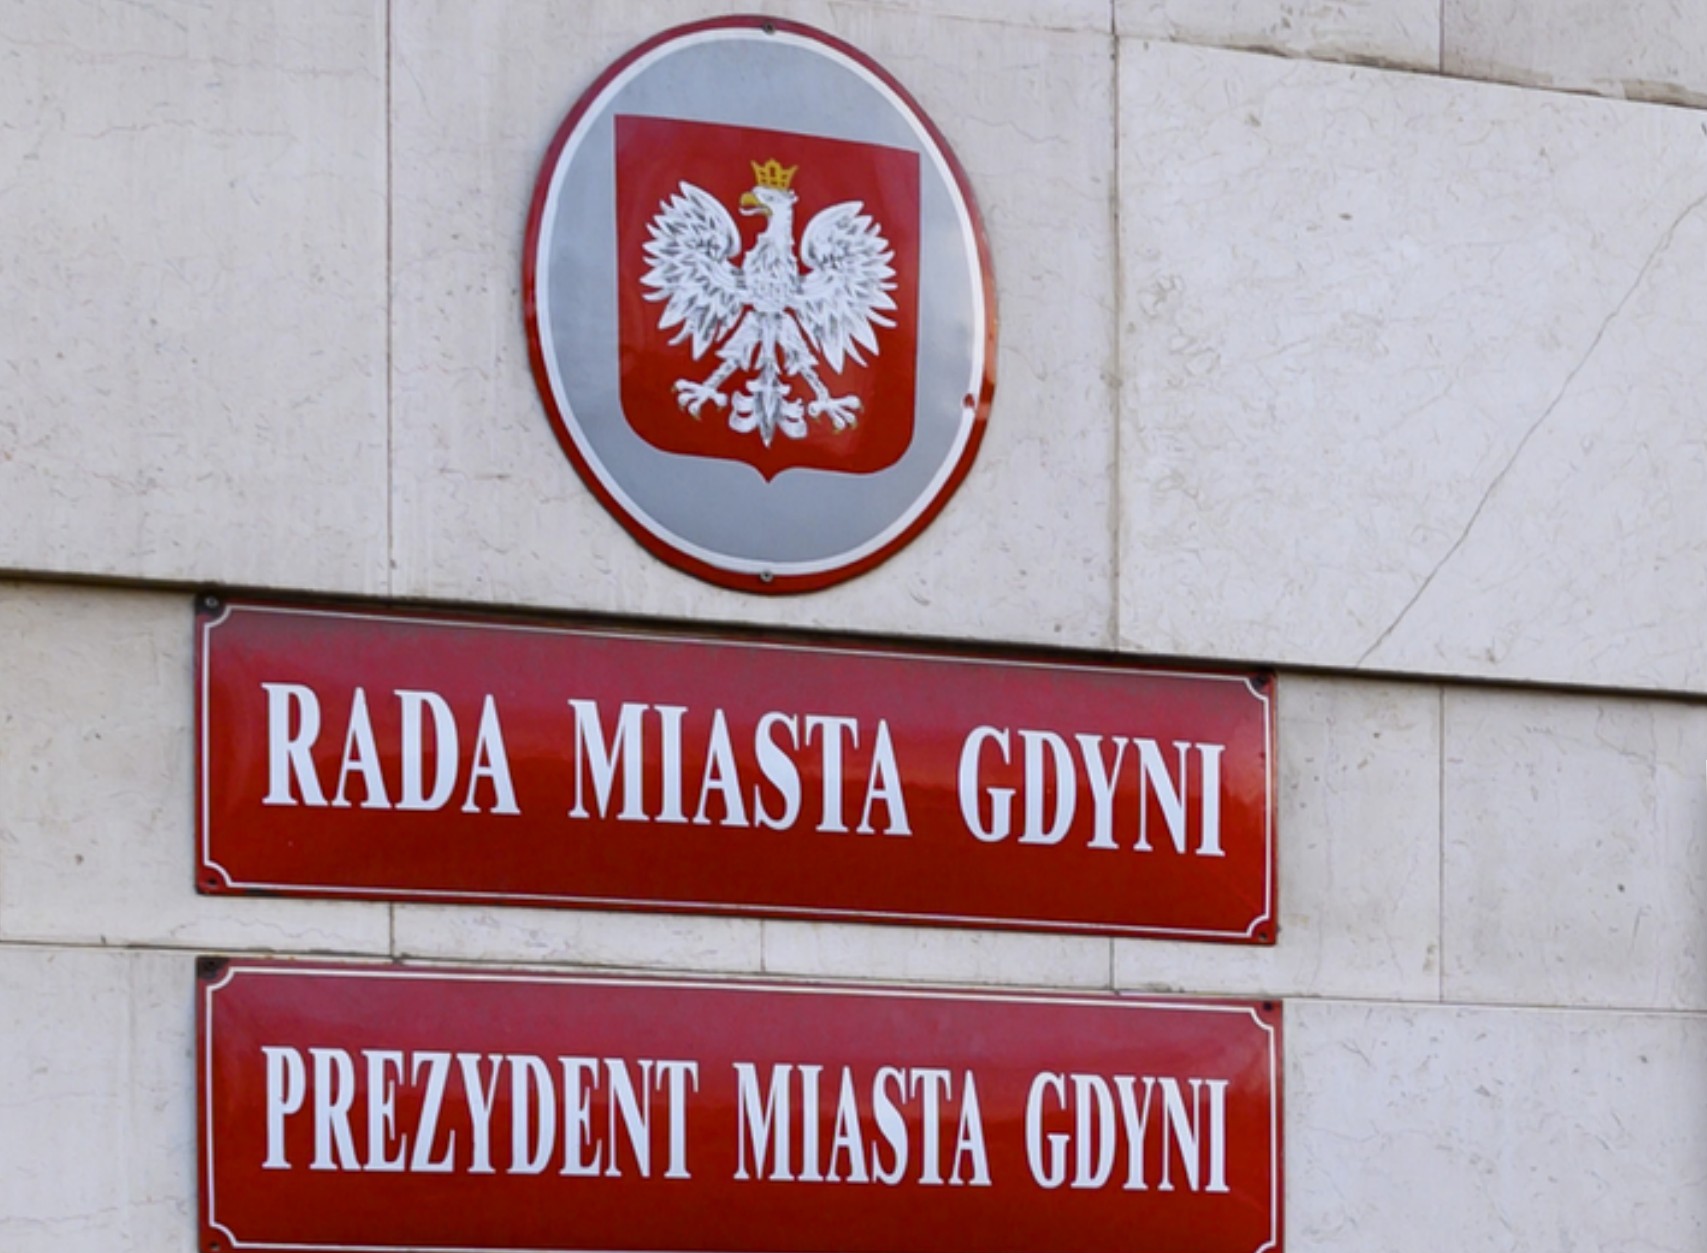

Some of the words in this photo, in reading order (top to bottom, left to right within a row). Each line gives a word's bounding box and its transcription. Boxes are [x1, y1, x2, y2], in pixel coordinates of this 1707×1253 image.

[261, 682, 521, 815] RADA
[568, 699, 912, 837] MIASTA
[958, 725, 1226, 857] GDYNI
[261, 1045, 699, 1179] PREZYDENT
[732, 1062, 992, 1187] MIASTA
[1025, 1071, 1230, 1193] GDYNI
